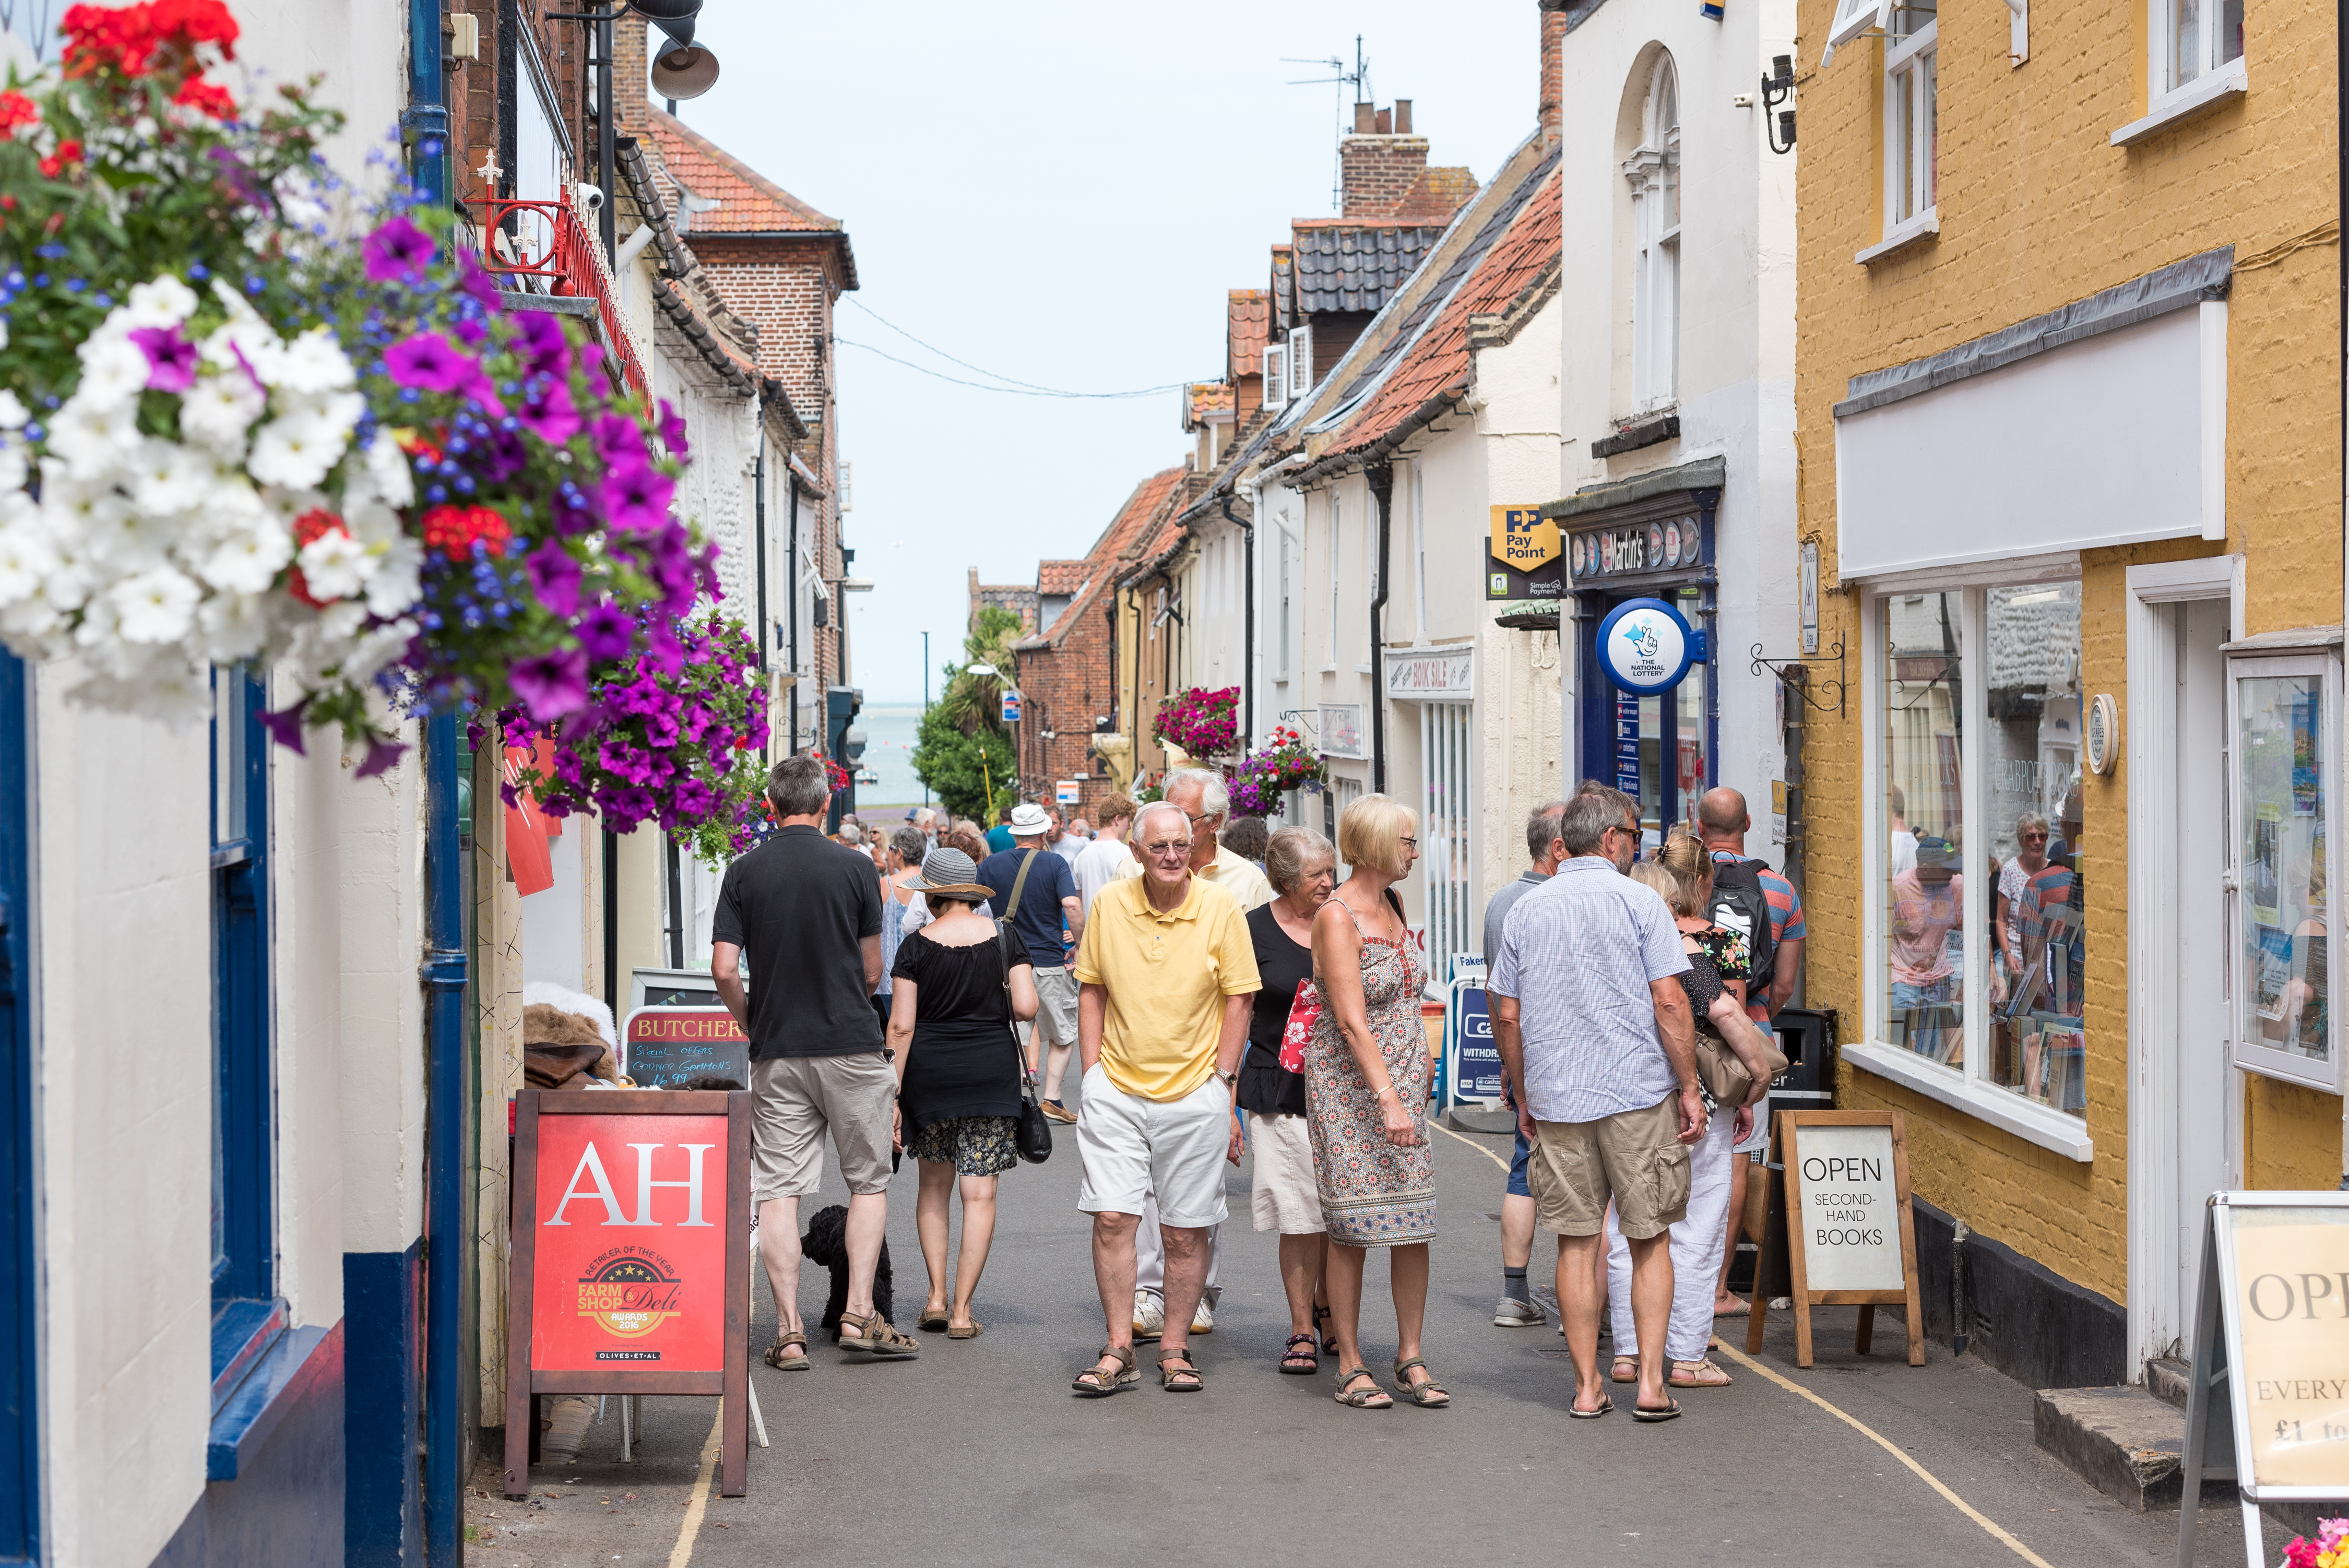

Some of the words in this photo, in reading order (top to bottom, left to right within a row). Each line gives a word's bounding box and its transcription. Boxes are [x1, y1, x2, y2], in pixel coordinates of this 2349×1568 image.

[1506, 534, 1532, 549] Pay
[1506, 547, 1545, 559] Point
[1610, 529, 1643, 571] Martin's
[1809, 550, 1812, 563] is
[1812, 552, 1815, 563] a
[1414, 661, 1430, 687] BOOK
[1431, 661, 1446, 687] SALE
[2092, 727, 2104, 738] GRAPES
[1995, 758, 2039, 794] CRABPOT
[637, 1020, 743, 1037] BUTCHER
[681, 1046, 713, 1055] OFFERS
[633, 1061, 675, 1072] CORNER
[679, 1060, 731, 1072] GAMMONS
[1804, 1157, 1881, 1182] OPEN
[543, 1141, 715, 1227] AH
[1815, 1193, 1877, 1206] SECOND-
[1826, 1210, 1866, 1221] HAND
[1817, 1229, 1883, 1245] BOOKS
[585, 1247, 622, 1276] RETAILER
[638, 1246, 656, 1259] THE
[656, 1254, 674, 1277] YEAR
[578, 1284, 622, 1297] FARM
[619, 1284, 681, 1310] Deli
[626, 1291, 634, 1301] &
[577, 1297, 623, 1310] SHOP
[611, 1313, 648, 1321] AWARDS
[2274, 1419, 2305, 1442] £1
[2322, 1420, 2348, 1442] to
